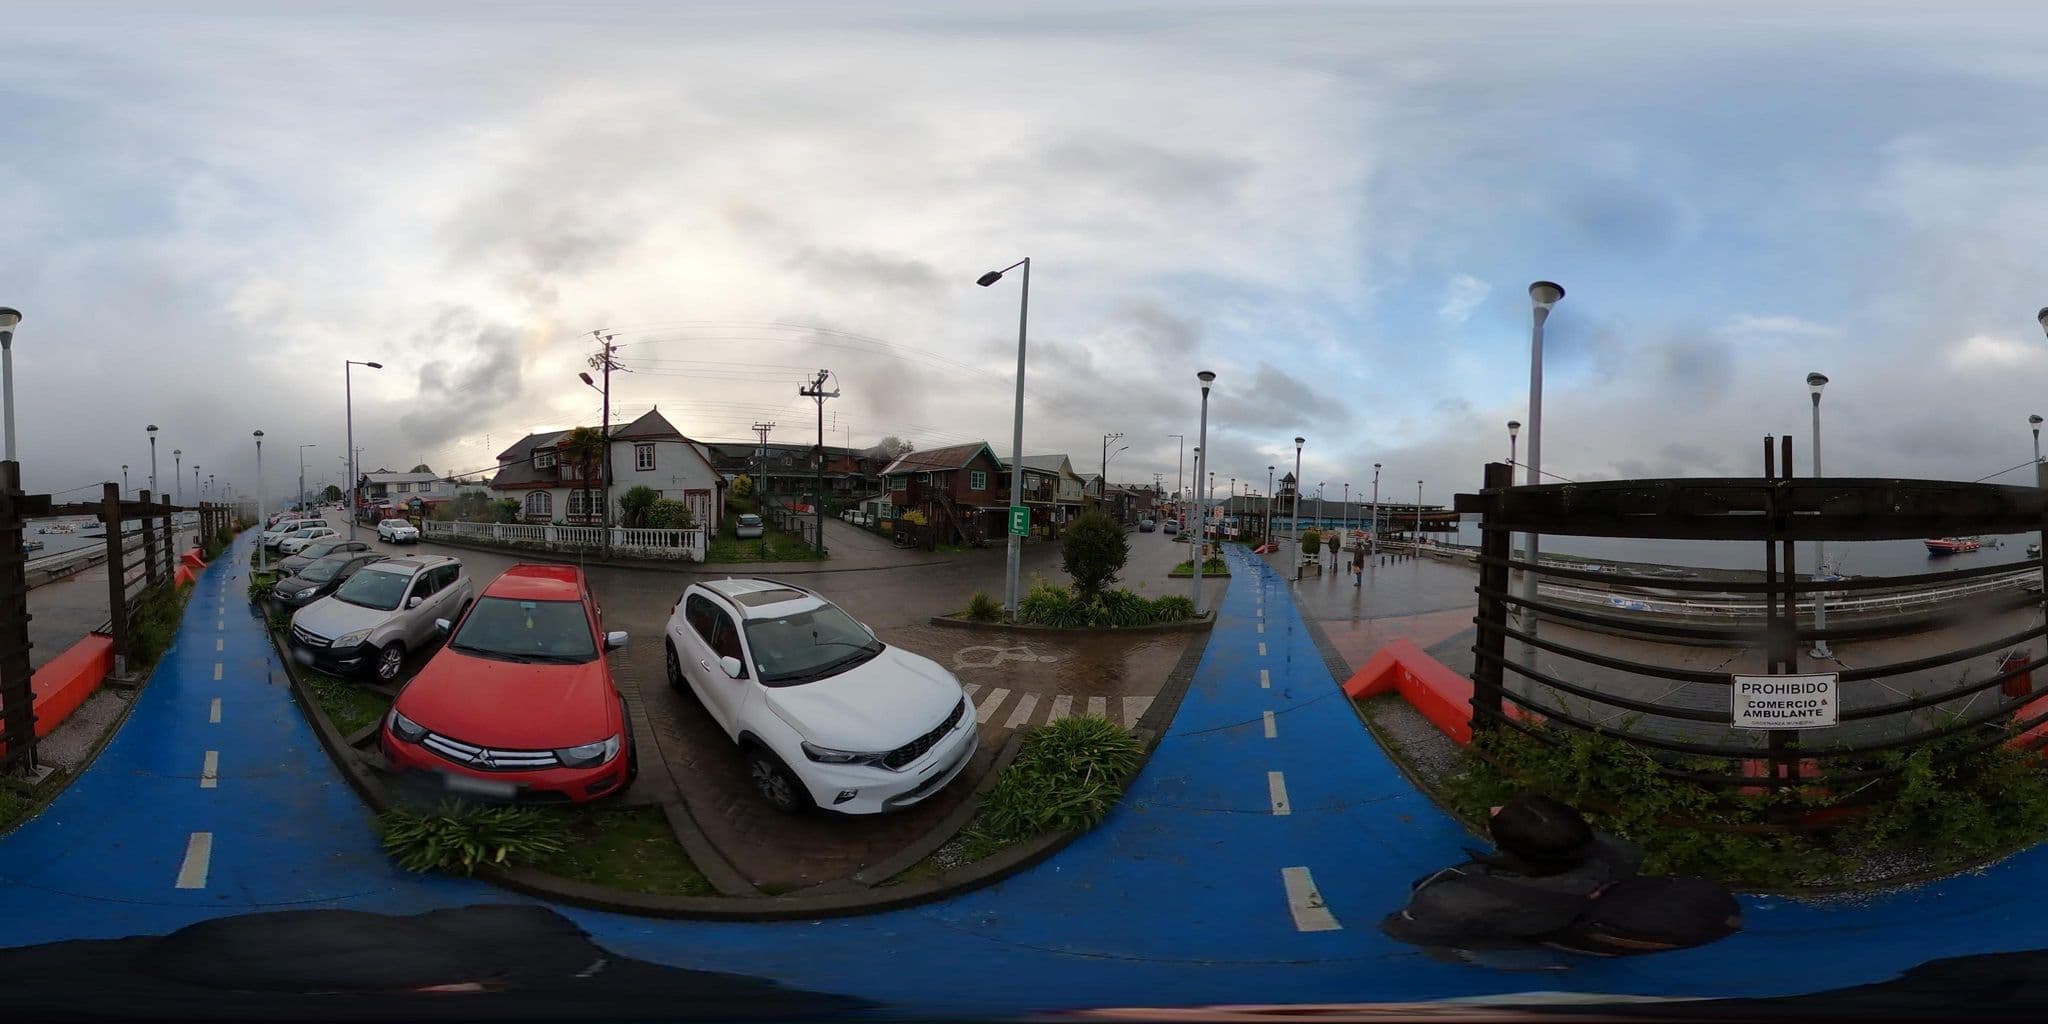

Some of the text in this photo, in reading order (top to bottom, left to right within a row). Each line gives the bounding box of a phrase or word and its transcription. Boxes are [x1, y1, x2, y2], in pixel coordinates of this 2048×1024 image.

[1014, 512, 1024, 529] E
[1741, 682, 1828, 694] PROHIBIDO
[1748, 700, 1817, 709] COMERCIO
[1743, 709, 1823, 718] AMBULANTE
